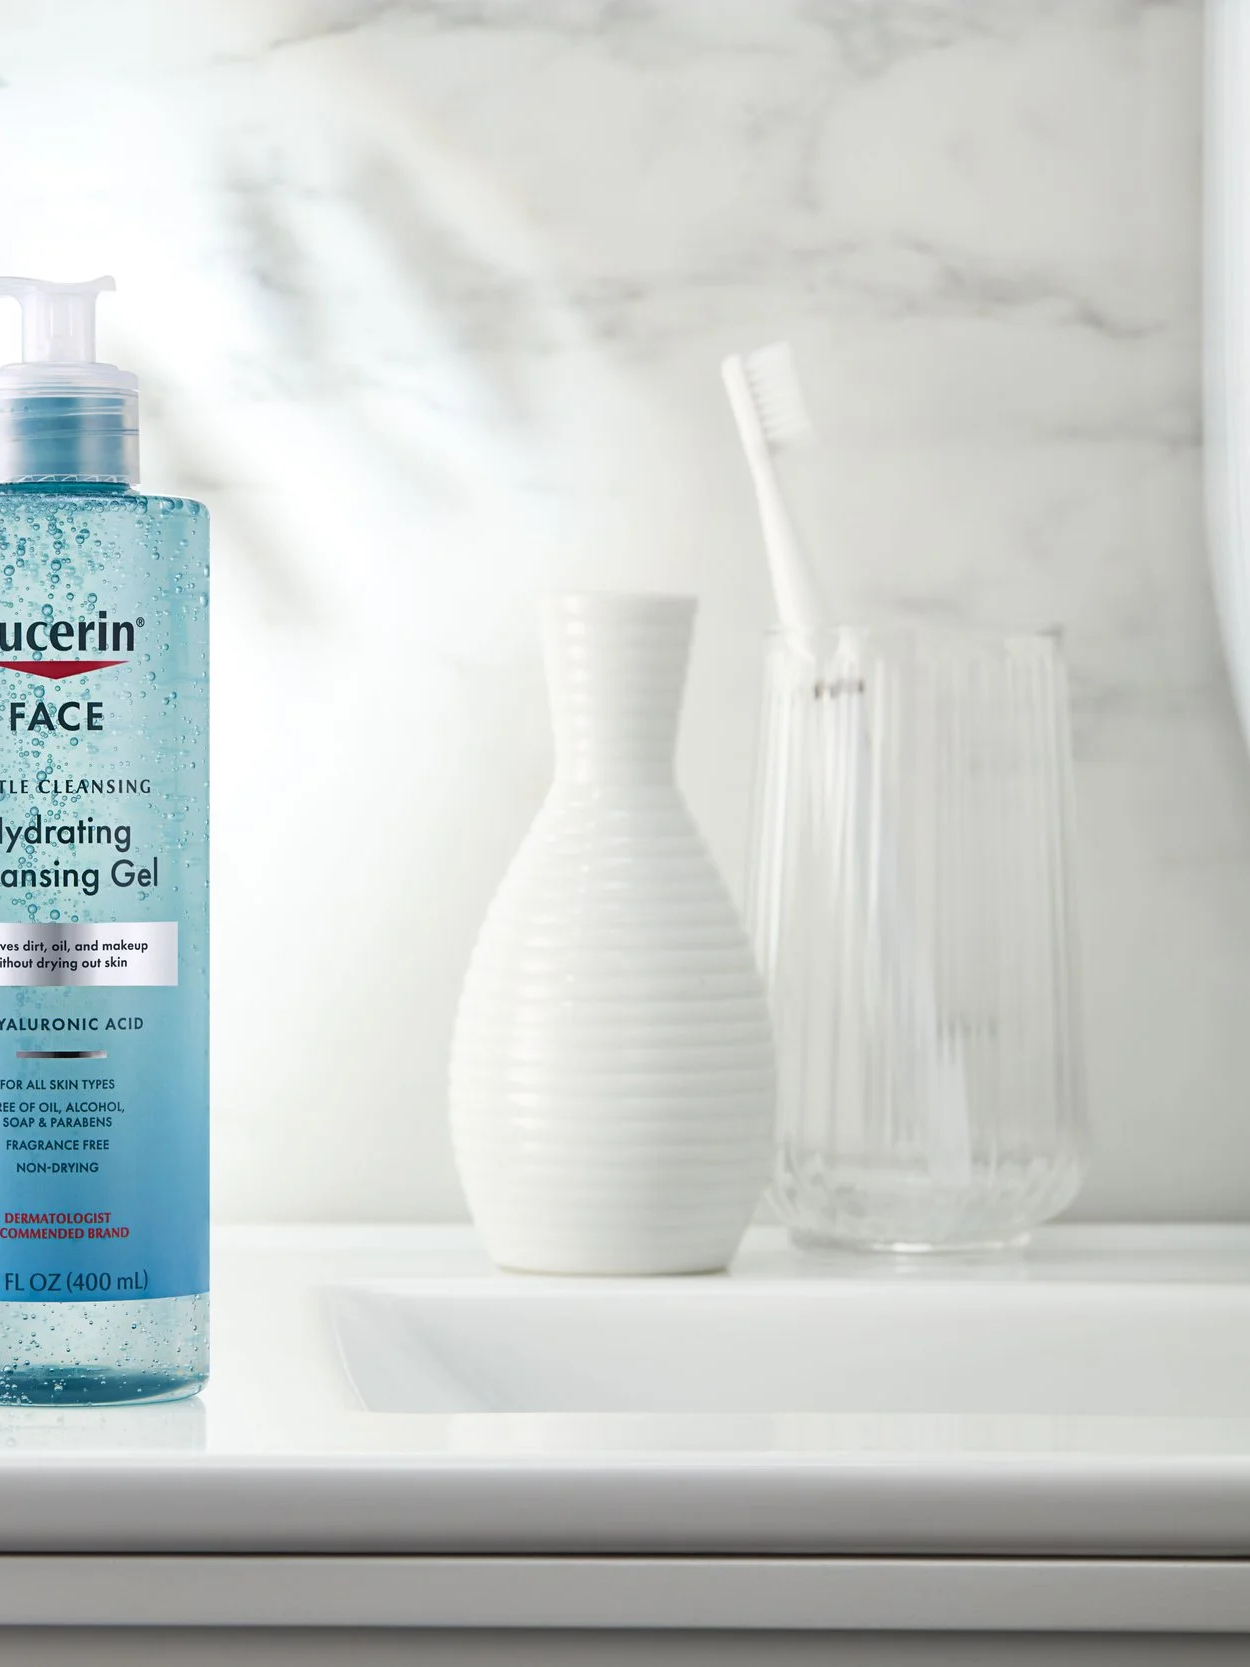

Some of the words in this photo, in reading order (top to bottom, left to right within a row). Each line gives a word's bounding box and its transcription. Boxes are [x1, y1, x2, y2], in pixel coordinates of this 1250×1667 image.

[10, 701, 103, 731] FACE
[38, 779, 151, 794] CLEANSING
[111, 856, 158, 888] Gel
[23, 940, 48, 953] dirt,
[52, 940, 71, 953] oil,
[74, 940, 98, 952] and
[102, 939, 148, 954] makeup
[36, 957, 78, 971] drying
[81, 958, 101, 969] out
[104, 956, 127, 968] skin
[105, 1017, 144, 1030] ACID
[0, 1079, 23, 1090] FOR
[26, 1079, 46, 1090] ALL
[49, 1079, 79, 1090] SKIN
[82, 1079, 115, 1090] TYPES
[20, 1102, 36, 1113] OF
[38, 1102, 62, 1115] OIL,
[65, 1101, 125, 1114] ALCOHOL,
[2, 1117, 35, 1128] SOAP
[38, 1117, 47, 1128] &
[50, 1117, 112, 1128] PARABENS
[6, 1139, 79, 1151] FRAGRANCE
[83, 1139, 109, 1150] FREE
[16, 1162, 99, 1173] NON-DRYING
[4, 1212, 111, 1224] DERMATOLOGIST
[88, 1227, 129, 1239] BRAND
[5, 1273, 24, 1292] FL
[29, 1273, 61, 1292] OZ
[66, 1271, 111, 1294] (400
[117, 1269, 148, 1292] mL)
